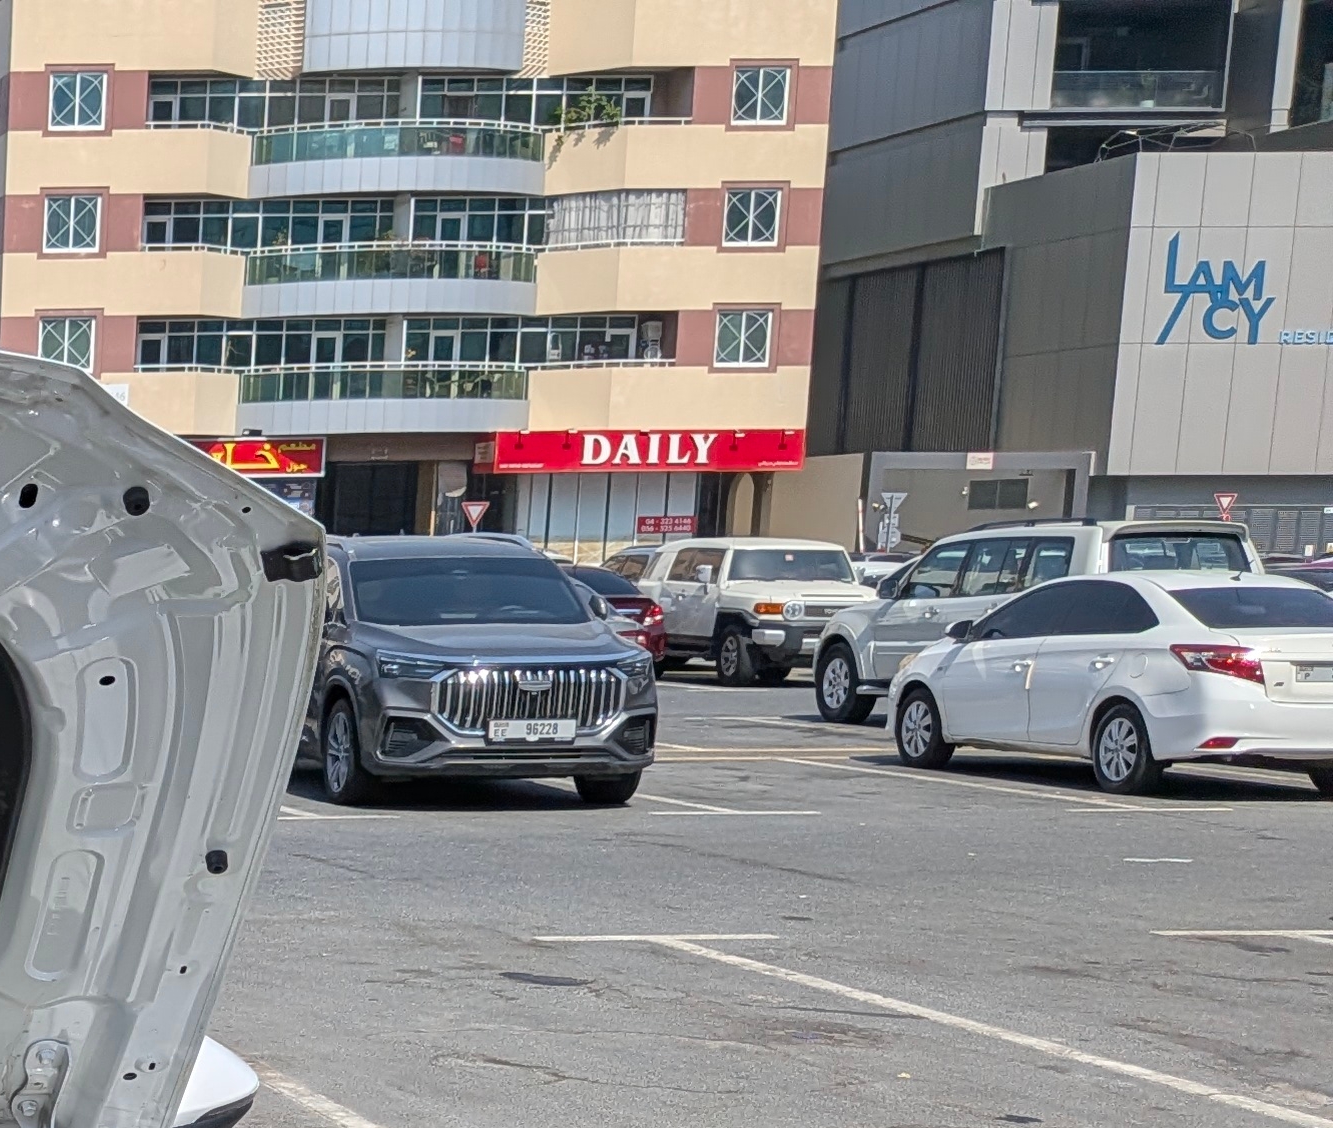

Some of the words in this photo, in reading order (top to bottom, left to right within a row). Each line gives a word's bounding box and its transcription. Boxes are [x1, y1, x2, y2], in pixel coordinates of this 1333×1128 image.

[581, 433, 719, 465] DAILY
[1304, 672, 1310, 680] P
[494, 729, 507, 737] EE
[525, 722, 559, 735] 96228
